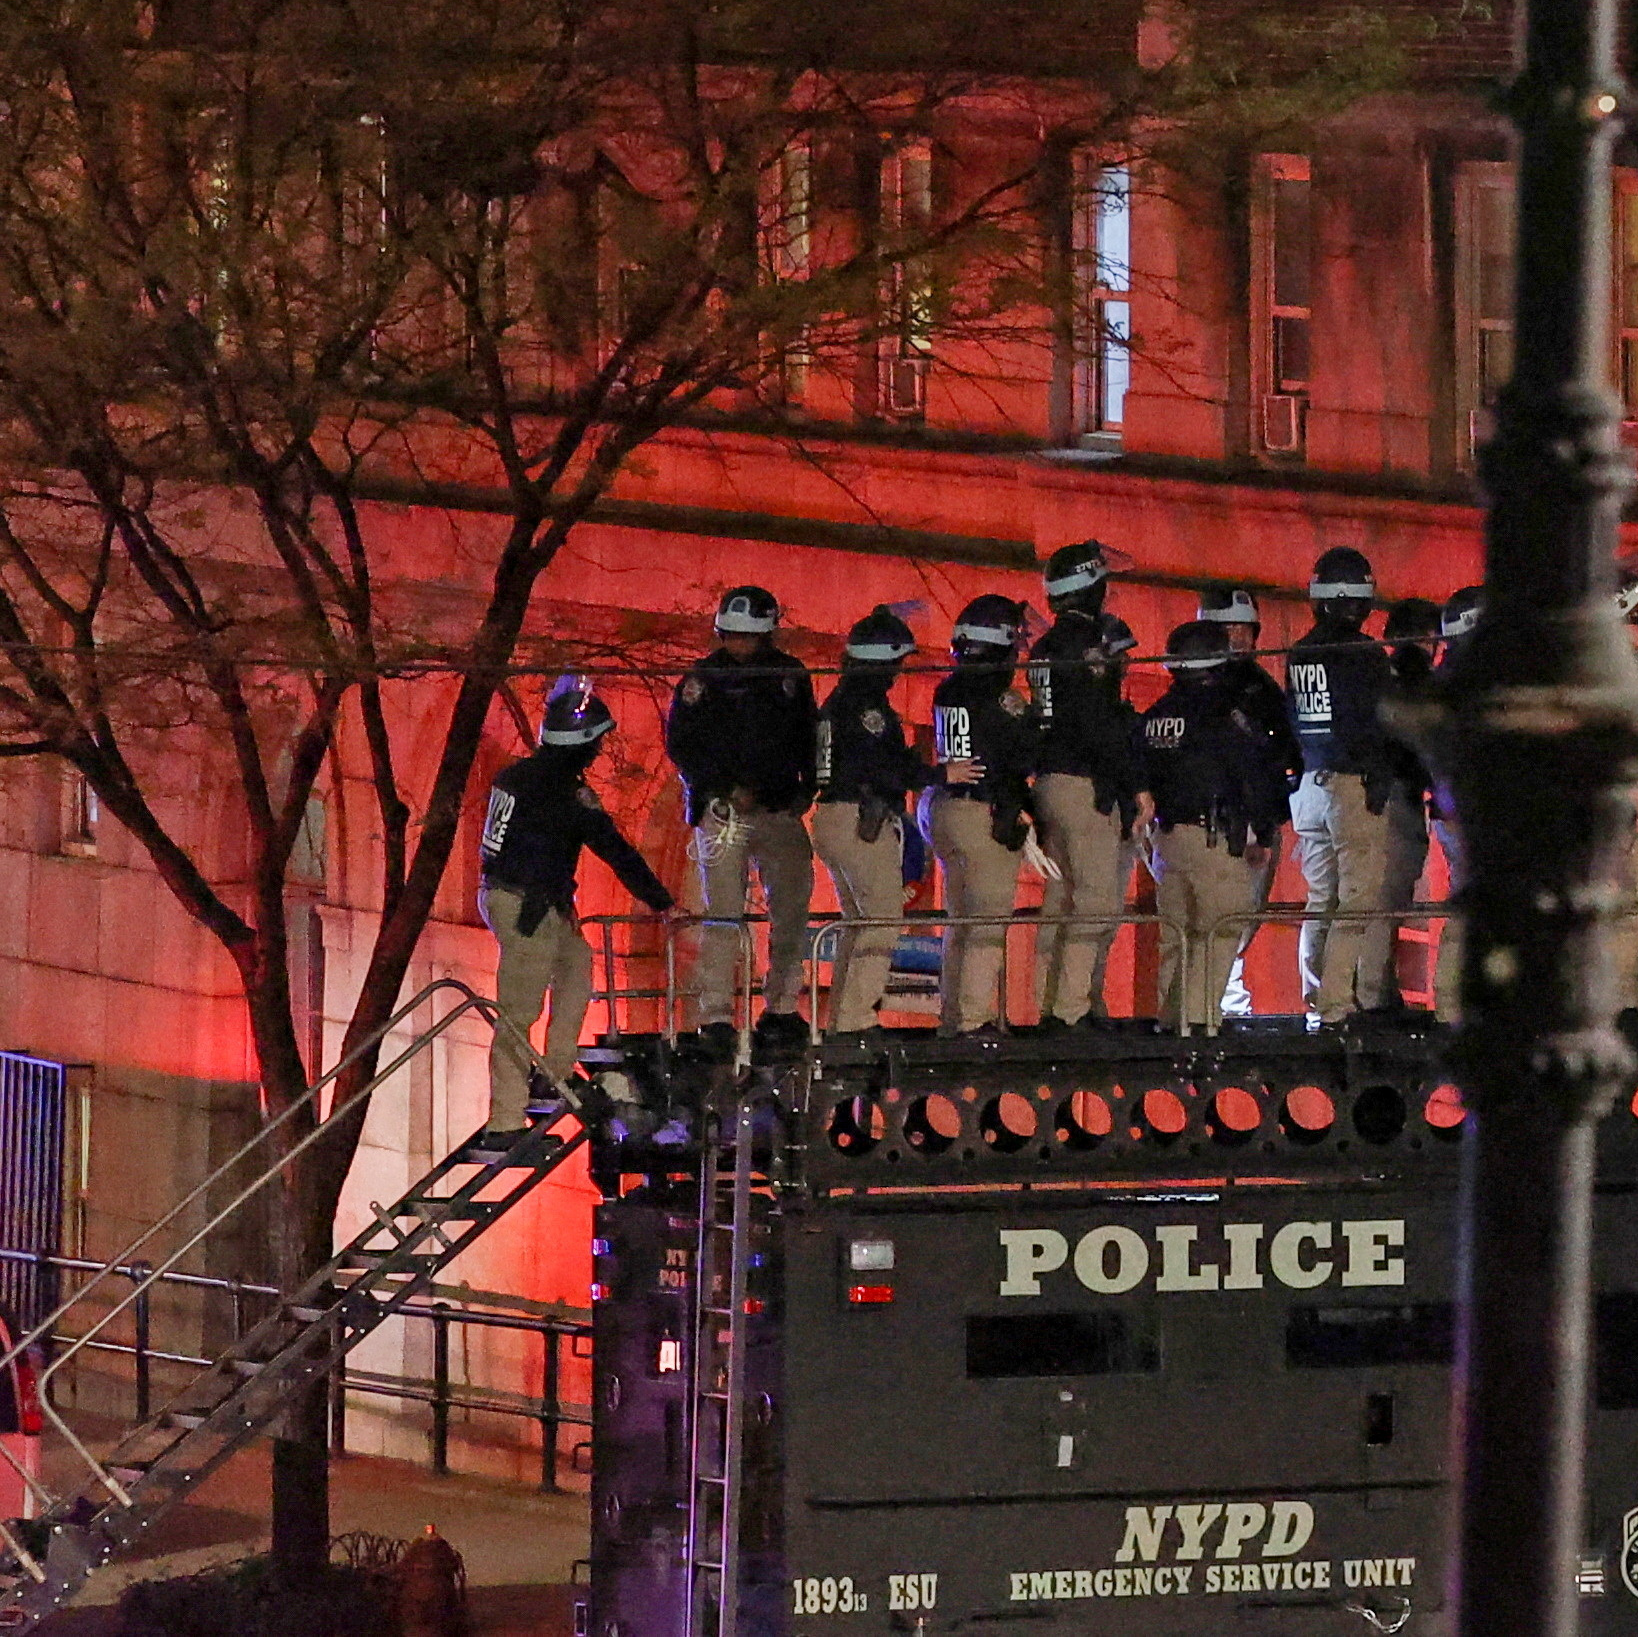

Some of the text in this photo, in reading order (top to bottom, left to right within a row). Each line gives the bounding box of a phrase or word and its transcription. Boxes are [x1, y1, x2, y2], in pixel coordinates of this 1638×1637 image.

[1289, 664, 1327, 693] NYPD
[1145, 717, 1185, 738] NYPD
[1000, 1219, 1405, 1297] POLICE
[1114, 1500, 1315, 1563] NYPD
[793, 1576, 854, 1615] 1893
[888, 1573, 938, 1611] ESU
[1010, 1558, 1416, 1601] EMERGENCY SERVICE UNIT
